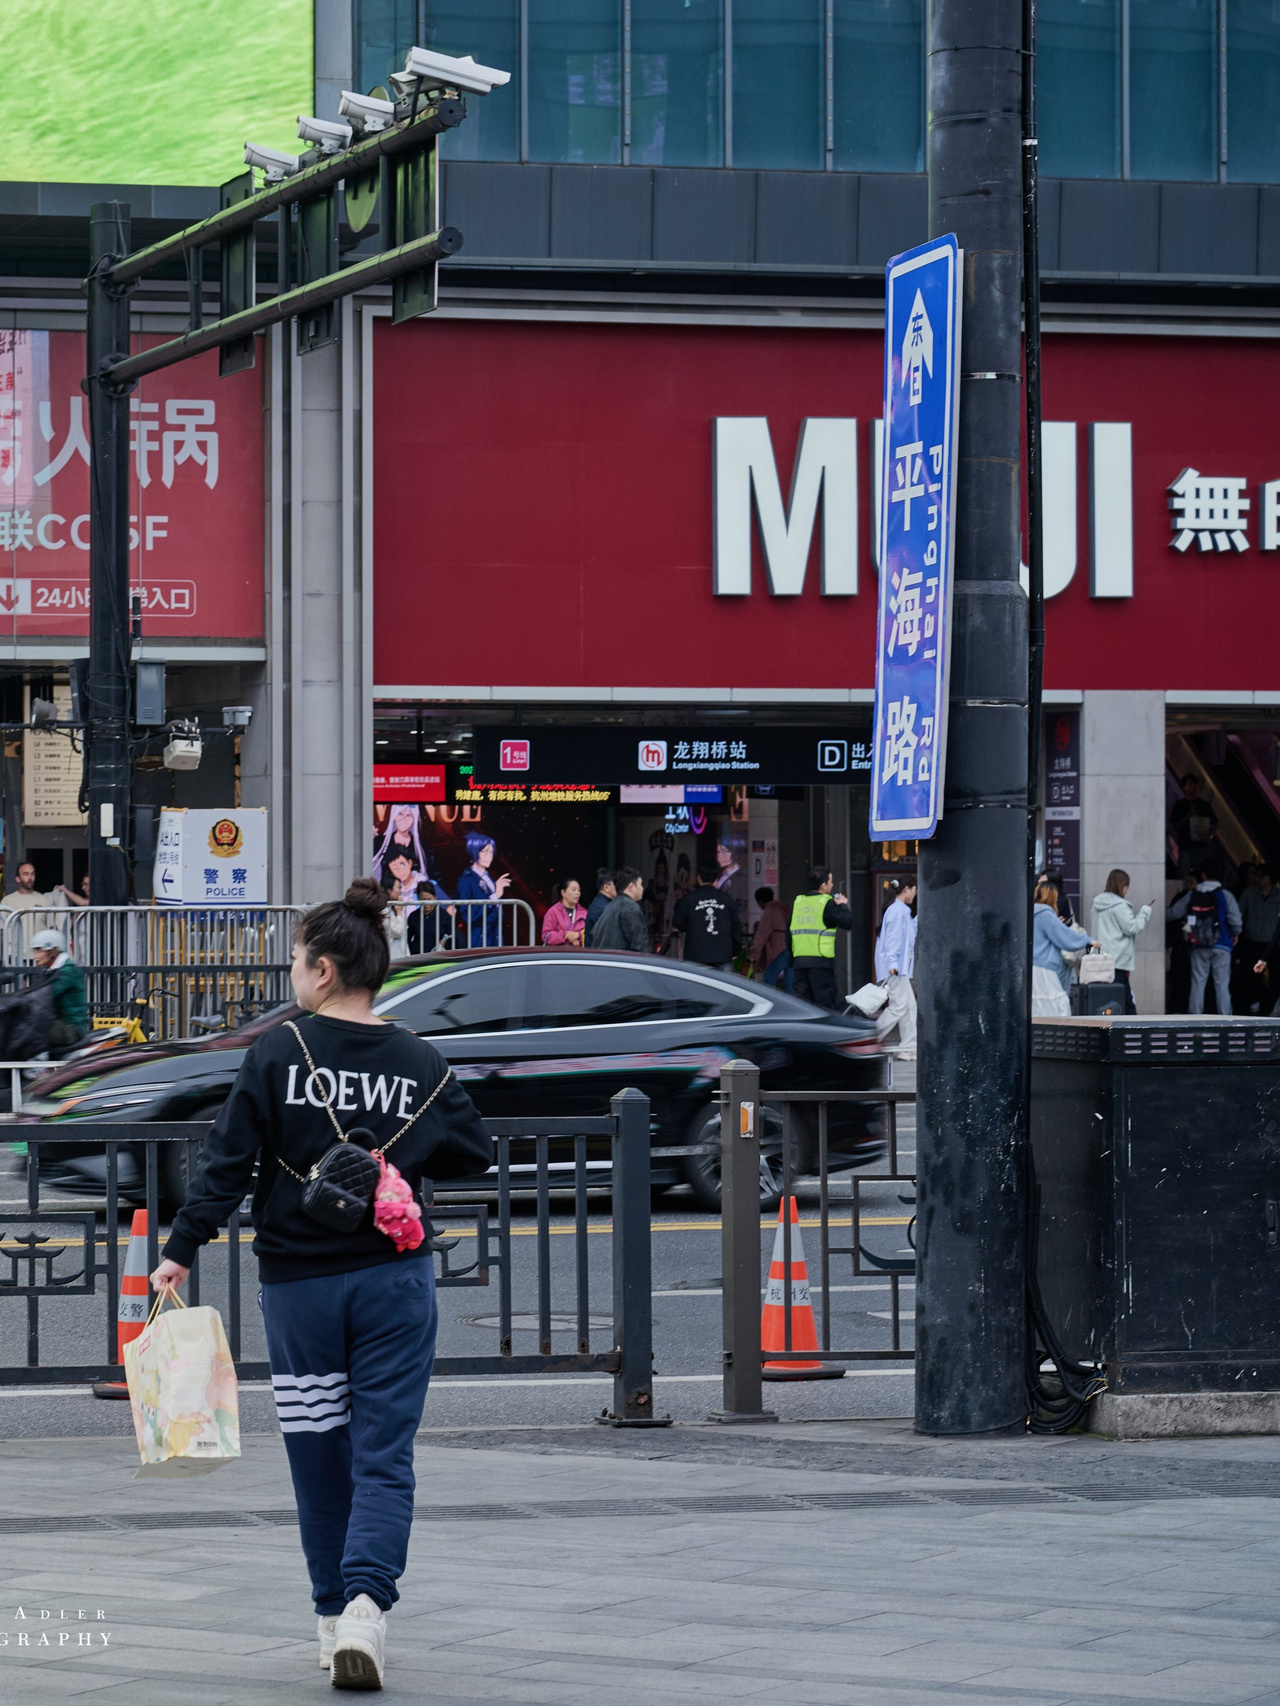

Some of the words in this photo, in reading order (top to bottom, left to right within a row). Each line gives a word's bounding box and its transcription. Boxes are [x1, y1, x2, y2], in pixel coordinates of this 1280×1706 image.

[911, 312, 923, 347] 东
[712, 415, 1135, 600] MJI
[1166, 467, 1280, 553] 無
[923, 444, 943, 660] Pinghai
[882, 440, 925, 786] 平海路
[672, 740, 748, 760] 龙翔桥站
[672, 761, 730, 771] Longxiangqiao
[730, 761, 760, 770] Station
[824, 745, 841, 766] D
[917, 716, 934, 782] Rd
[204, 867, 247, 885] 警察
[206, 887, 246, 897] POLICE
[285, 1064, 418, 1120] LOEWE
